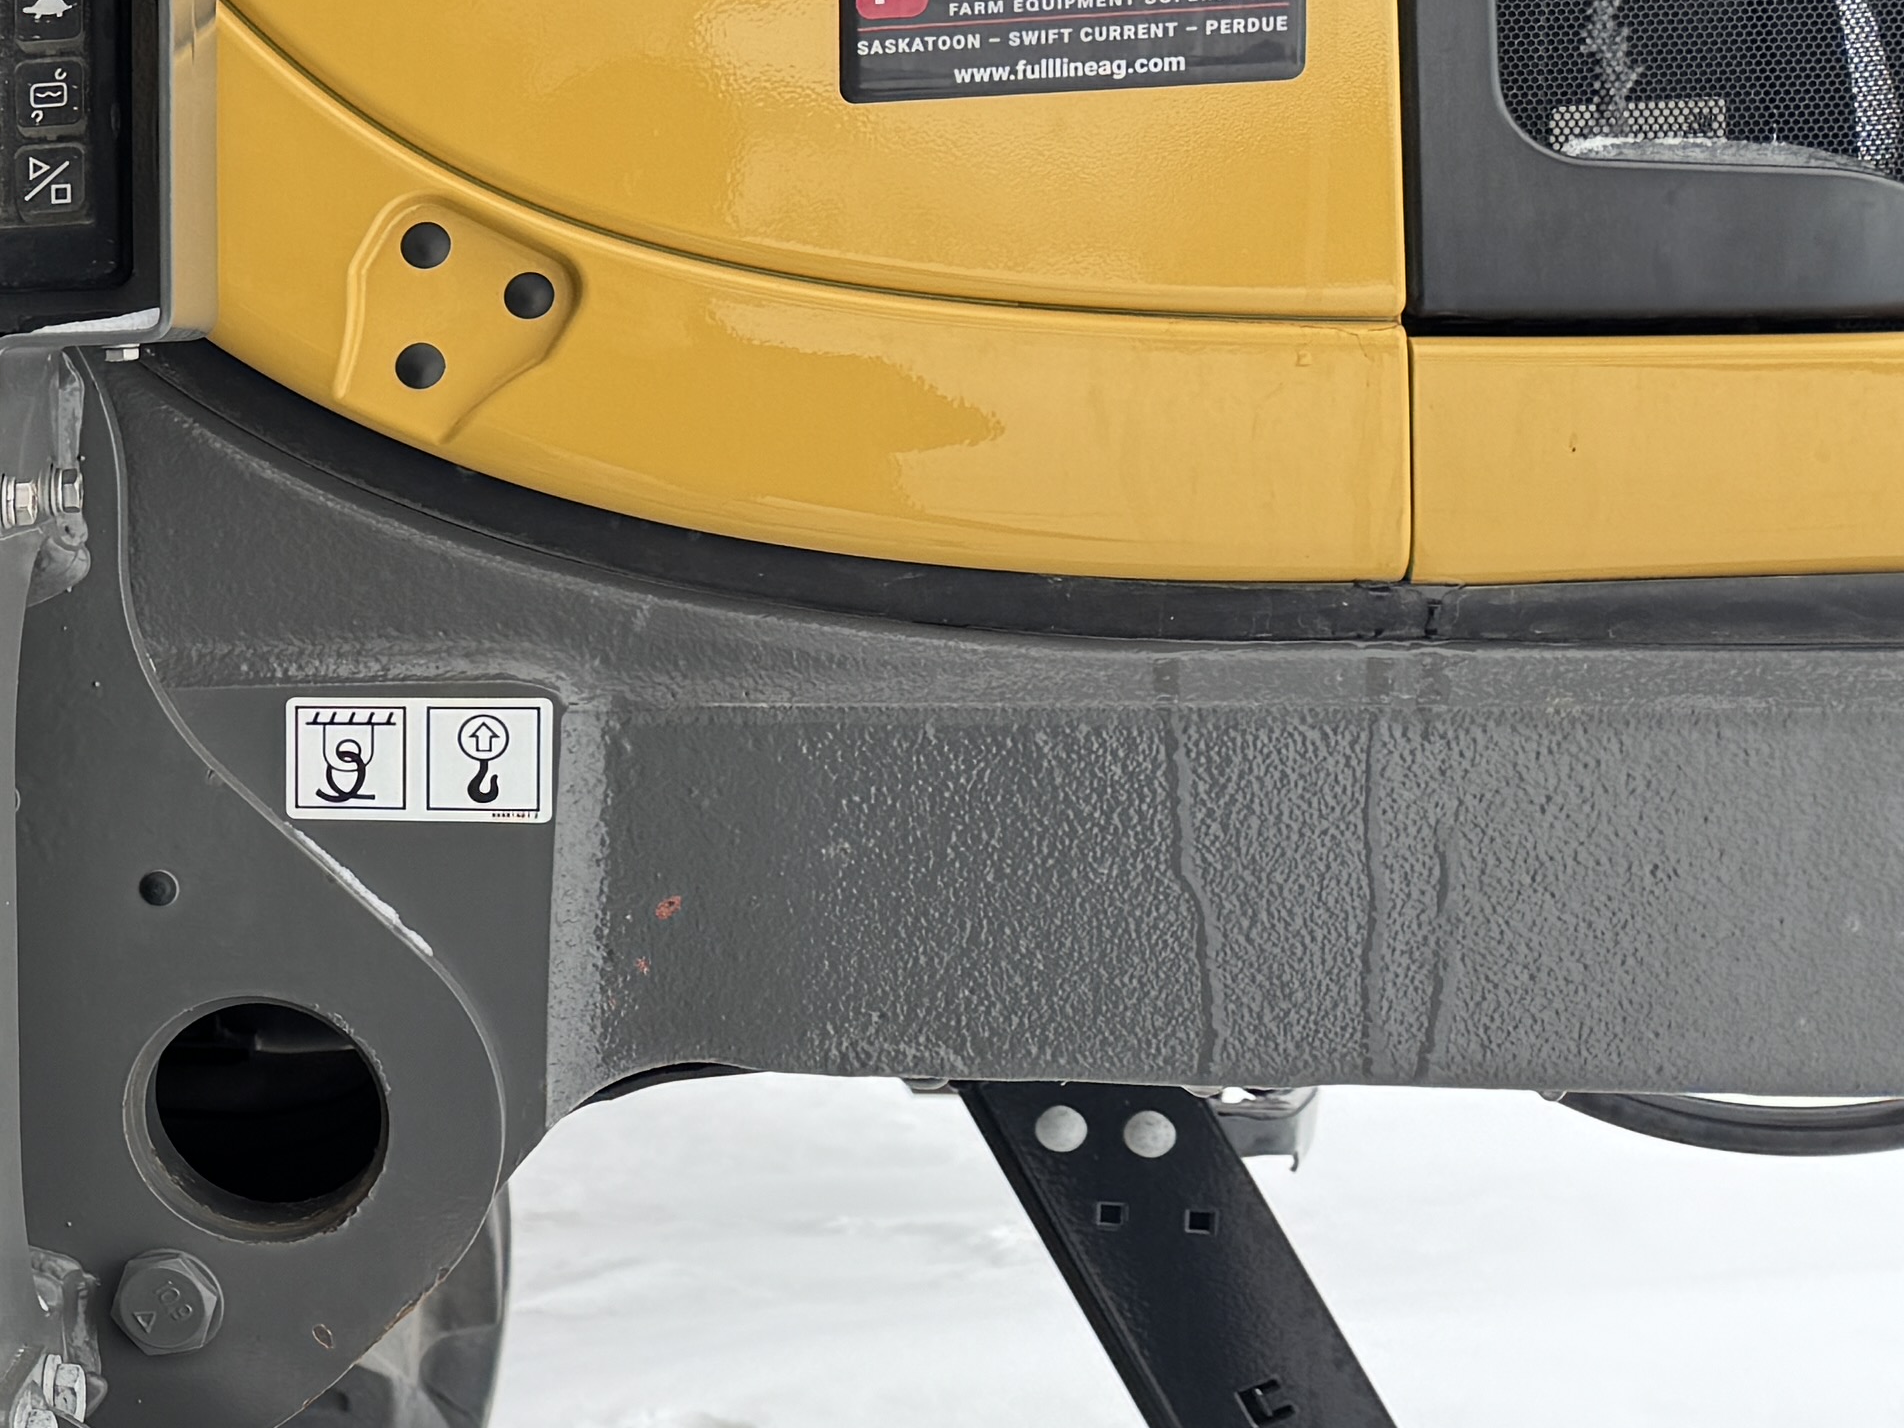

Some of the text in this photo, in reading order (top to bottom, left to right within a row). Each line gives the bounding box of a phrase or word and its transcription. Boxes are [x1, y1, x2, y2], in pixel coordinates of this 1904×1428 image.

[948, 0, 1004, 16] FARM
[856, 33, 981, 56] SASKATOON
[1008, 27, 1073, 47] SWIFT
[1079, 22, 1178, 43] CURRENT
[1205, 15, 1288, 36] PERDUE
[953, 54, 1186, 84] www.fulllineag.com
